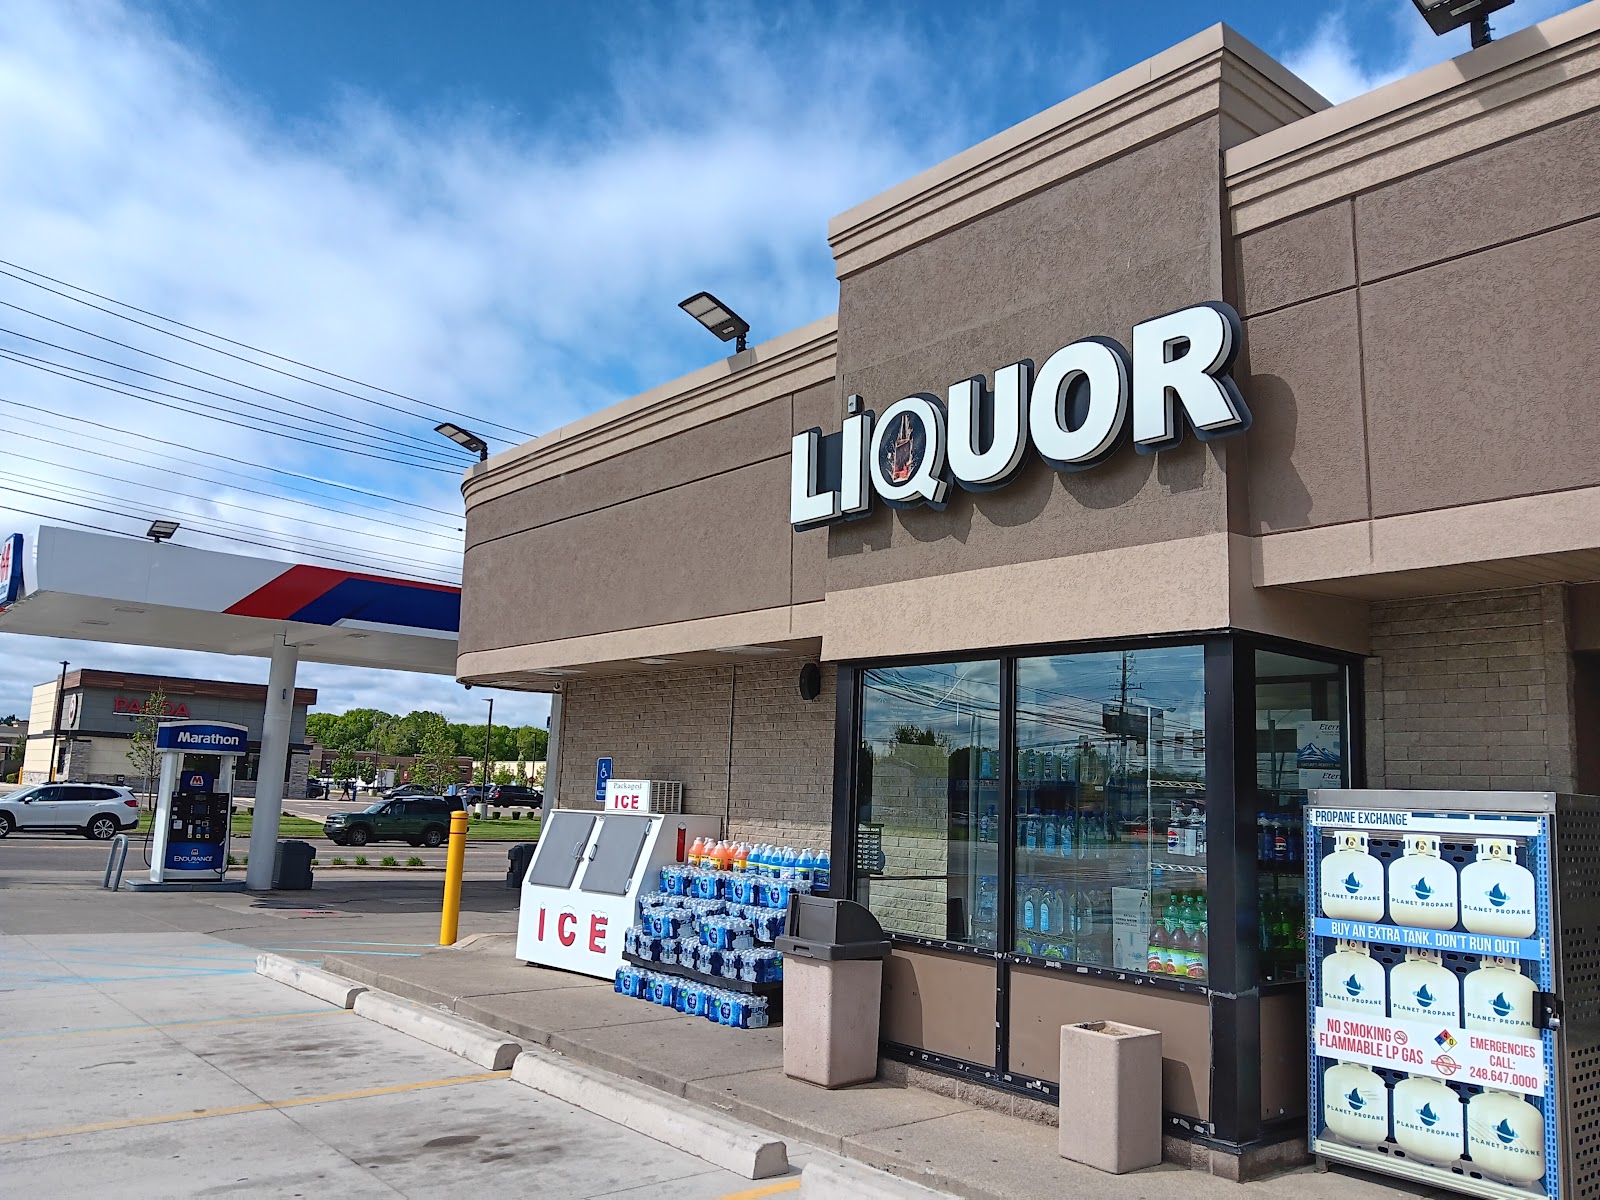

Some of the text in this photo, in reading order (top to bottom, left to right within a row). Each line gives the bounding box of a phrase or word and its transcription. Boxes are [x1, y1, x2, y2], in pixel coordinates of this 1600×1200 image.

[790, 303, 1245, 528] LIQUOR
[178, 732, 239, 745] Marathon
[614, 795, 639, 809] ICE
[1315, 810, 1356, 824] PROPANE
[1358, 812, 1408, 826] EXCHANGE
[1324, 892, 1348, 900] PLANET
[1392, 898, 1417, 907] PLANET
[1464, 904, 1492, 914] PLANET
[538, 905, 608, 954] ICE
[1332, 922, 1520, 955] BUY AN EXTRA TANK. DON'T RUN OUT!
[1325, 992, 1349, 1003] PLANET
[1394, 1004, 1456, 1016] PLANET PROPANE
[1468, 1012, 1496, 1022] PLANET
[1327, 1018, 1392, 1042] NO SMOKING
[1320, 1033, 1424, 1064] FLAMMABLE LP GAS
[1470, 1036, 1536, 1058] EMERGENCIES
[1490, 1055, 1516, 1070] CALL:
[1470, 1066, 1538, 1090] 248.647.0000
[1326, 1104, 1384, 1120] PLANET PROPANE
[1396, 1120, 1460, 1138] PLANET PROPANE
[1470, 1136, 1540, 1156] PLANET PROPANE
